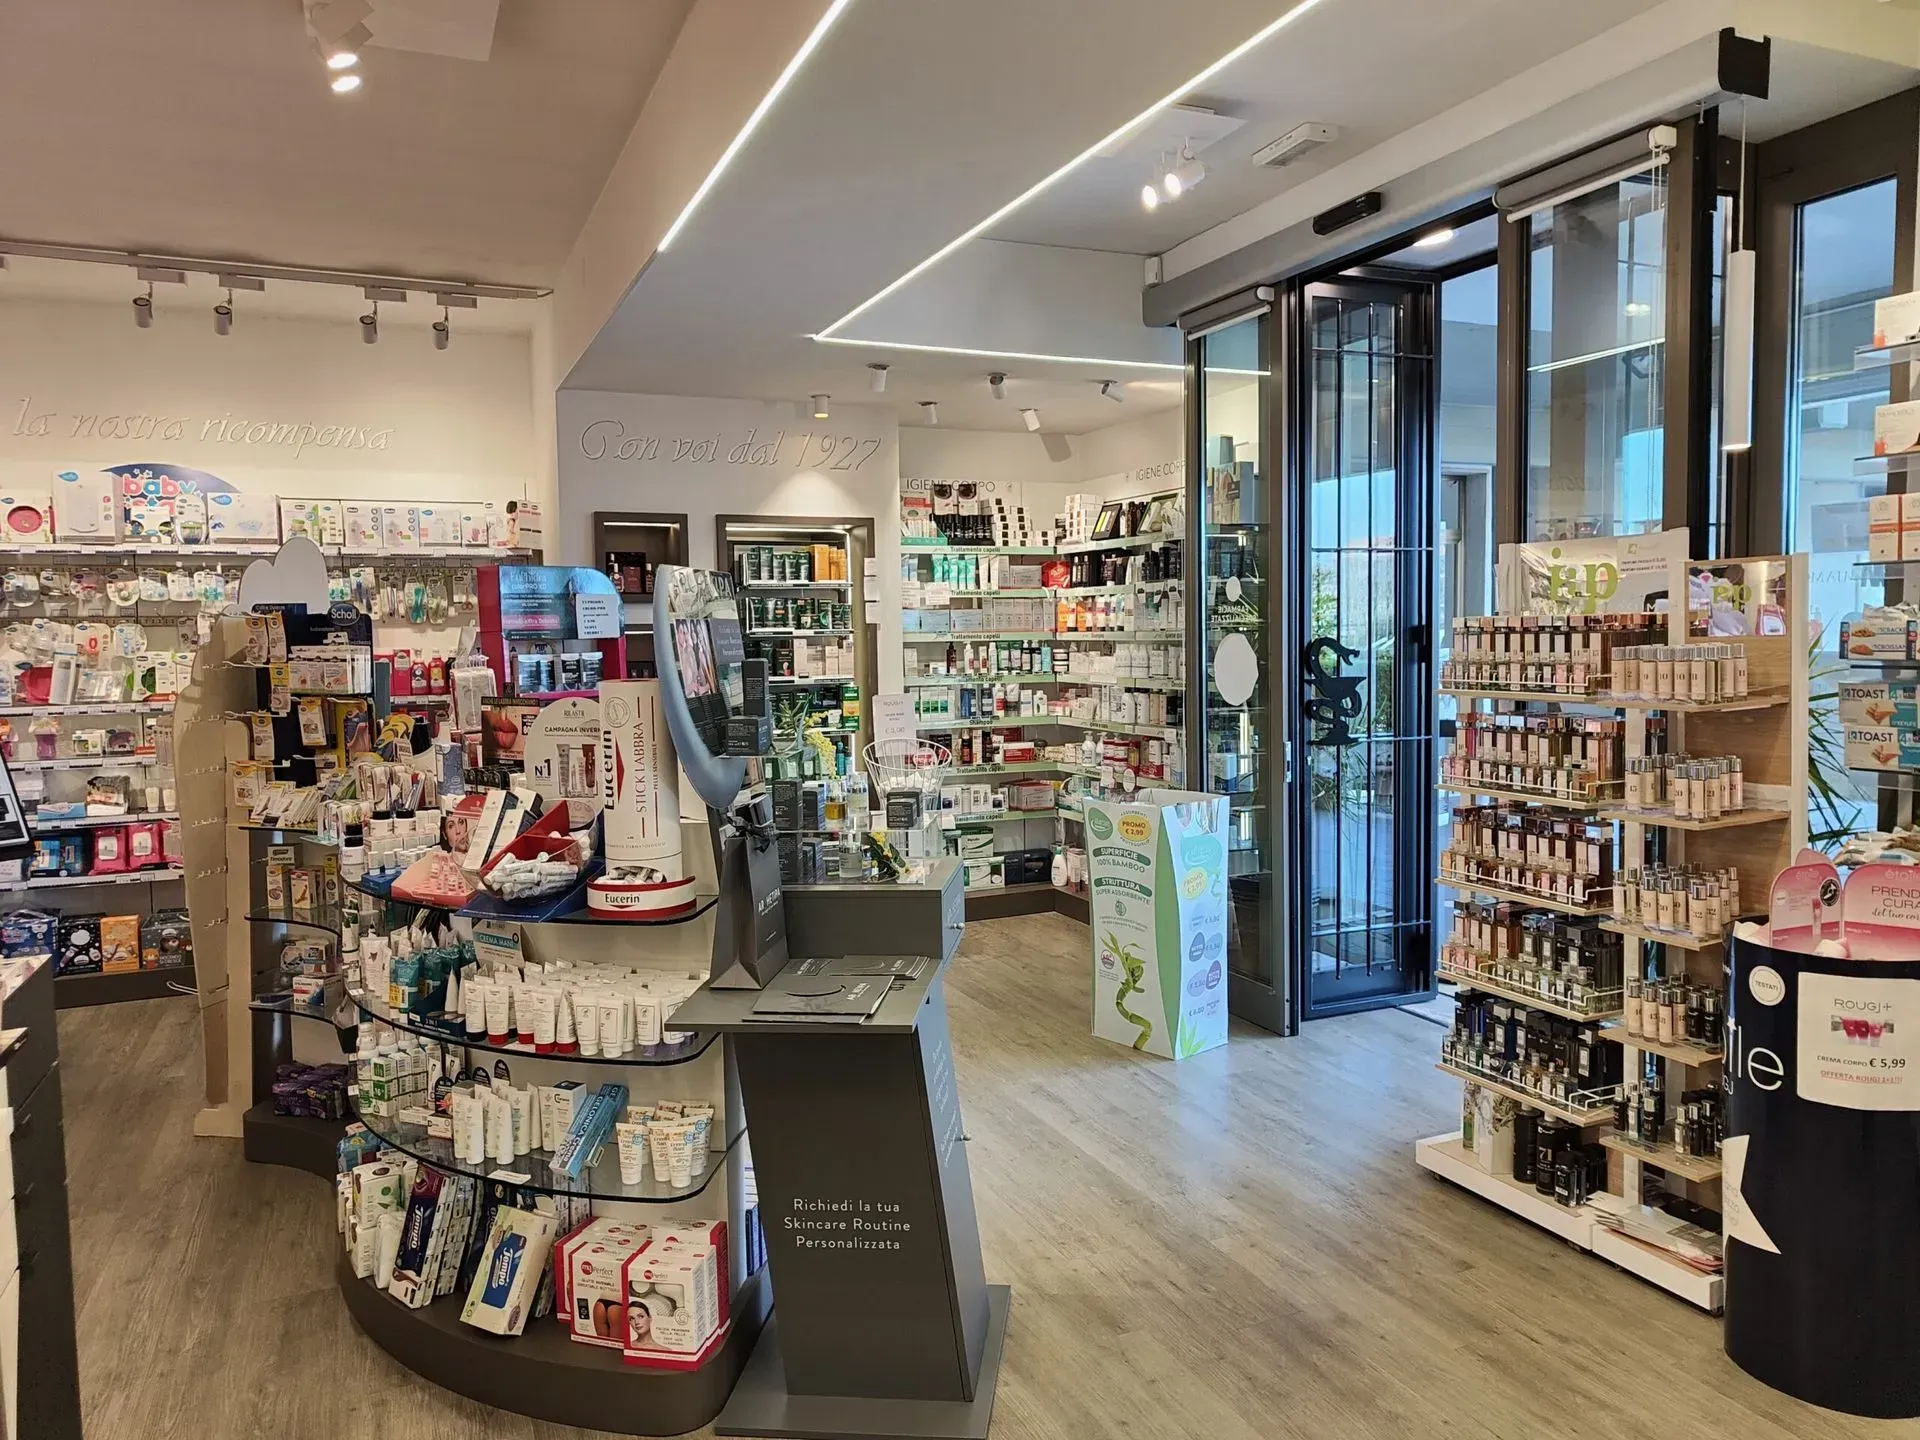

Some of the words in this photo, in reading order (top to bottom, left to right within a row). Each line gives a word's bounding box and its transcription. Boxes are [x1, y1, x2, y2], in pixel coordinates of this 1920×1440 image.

[13, 396, 57, 437] la
[69, 412, 190, 441] nostra
[199, 413, 395, 459] ricompensa
[671, 432, 721, 464] voi
[727, 428, 786, 465] dal
[795, 430, 882, 471] 1927
[331, 610, 357, 620] Scholl
[1851, 688, 1885, 699] TOAST
[1858, 731, 1894, 742] TOAST
[632, 722, 646, 768] LABBRA
[602, 729, 615, 811] Eucerin
[635, 771, 648, 813] STICK
[1122, 820, 1146, 829] PROMO
[1100, 847, 1138, 859] SUPERFICIE
[1112, 859, 1145, 873] BAMBOO
[1101, 879, 1140, 891] STRUTTURA
[605, 892, 640, 904] Eucerin
[1817, 1055, 1842, 1064] CREMA
[1843, 1059, 1868, 1067] CORPO
[1869, 1058, 1877, 1068] €
[1880, 1058, 1906, 1070] 5,99
[1821, 1070, 1855, 1080] OFFERTA
[793, 1198, 853, 1212] Richiedi
[859, 1200, 871, 1212] la
[877, 1202, 900, 1213] tua
[784, 1217, 847, 1230] Skincare
[853, 1218, 911, 1231] Routine
[796, 1236, 900, 1250] Personalizzata
